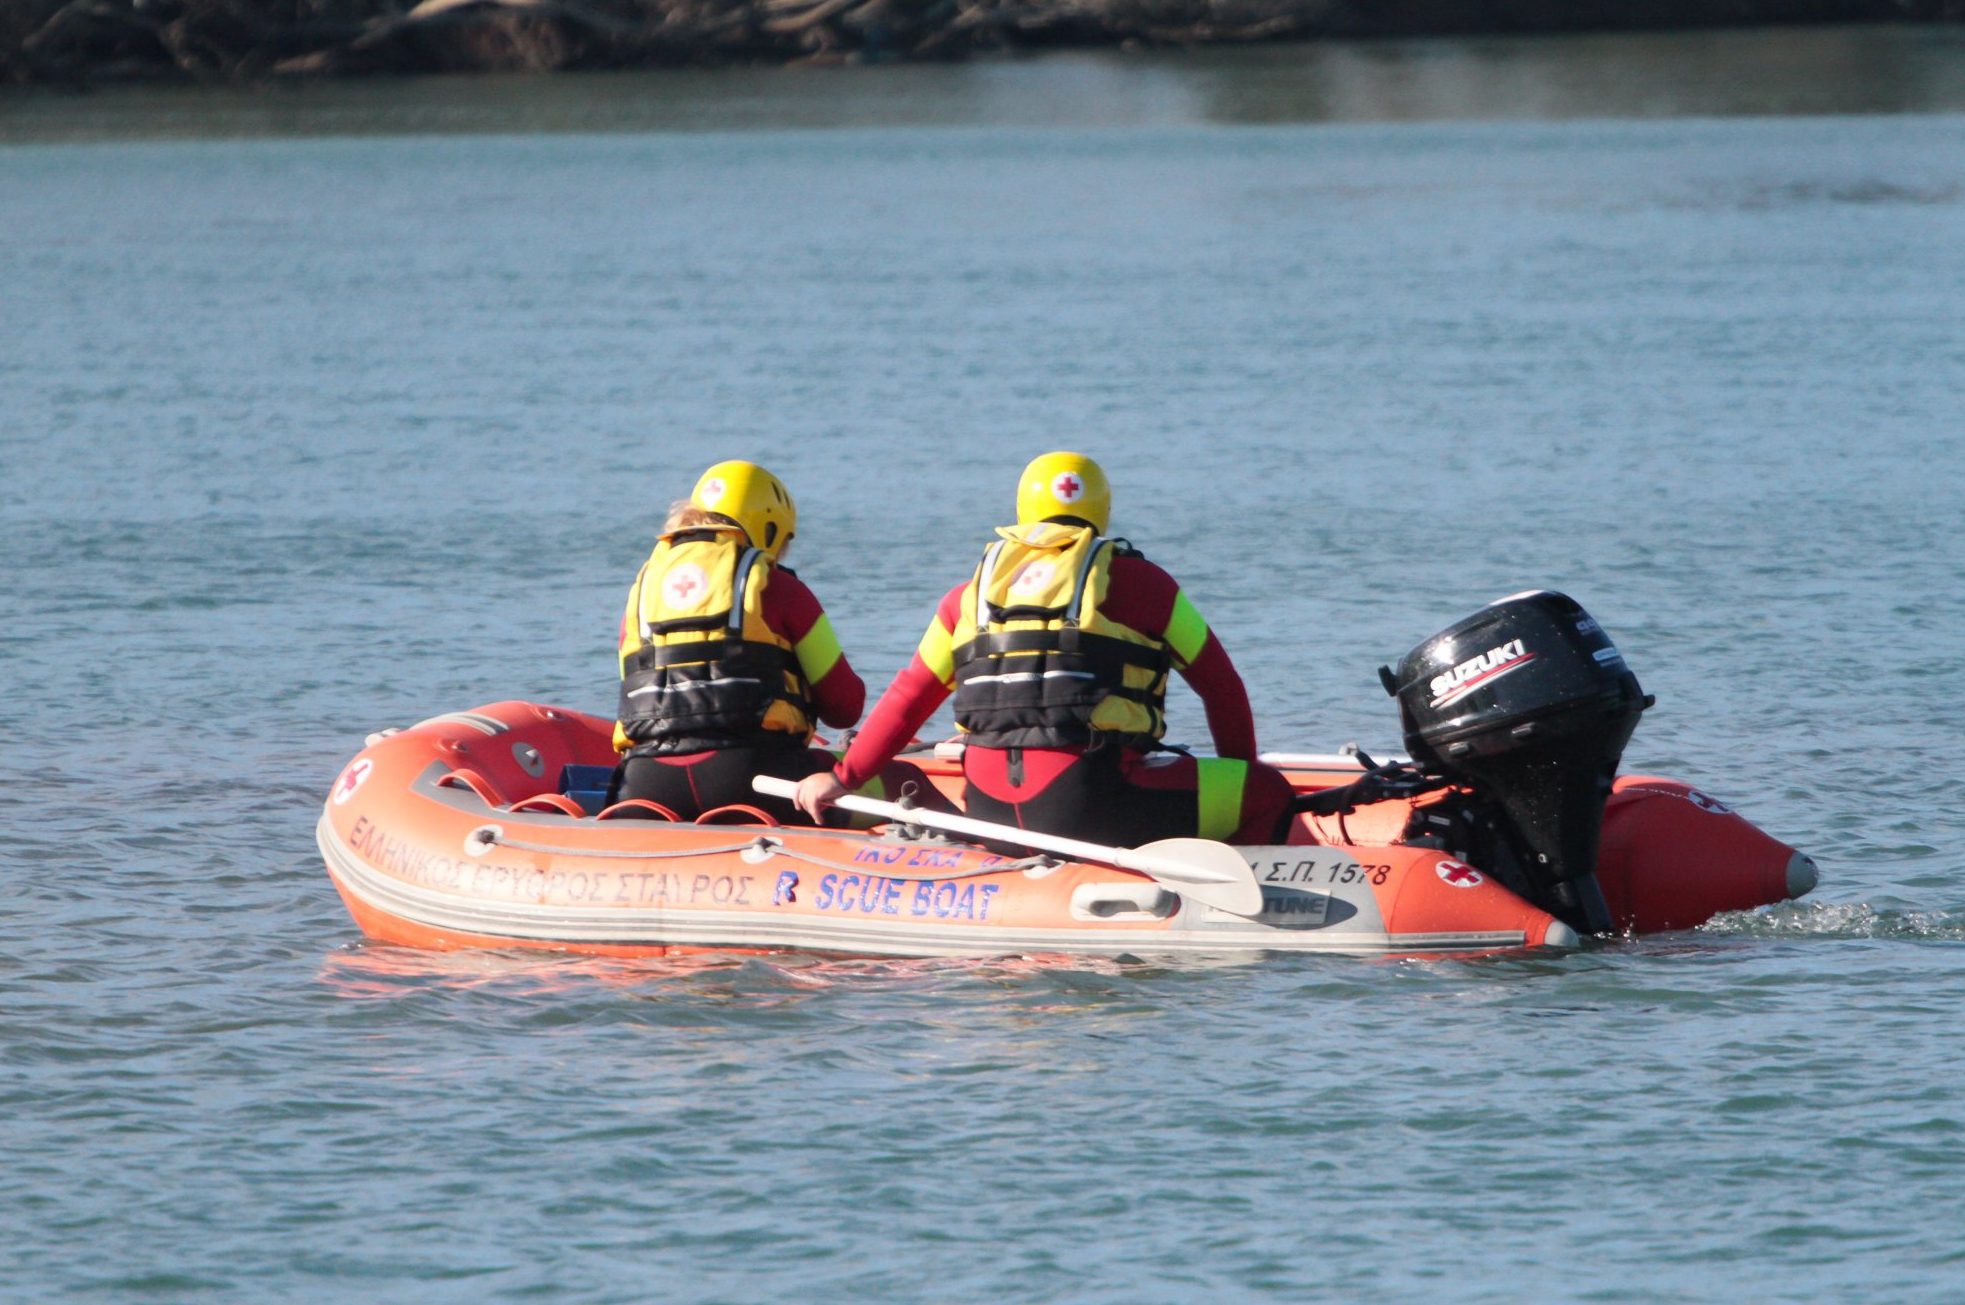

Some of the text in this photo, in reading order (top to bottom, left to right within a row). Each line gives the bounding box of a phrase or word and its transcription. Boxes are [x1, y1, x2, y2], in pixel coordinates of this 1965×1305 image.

[1430, 638, 1526, 697] SUZUKI
[1327, 861, 1392, 886] 1578
[911, 880, 1000, 920] BOAT
